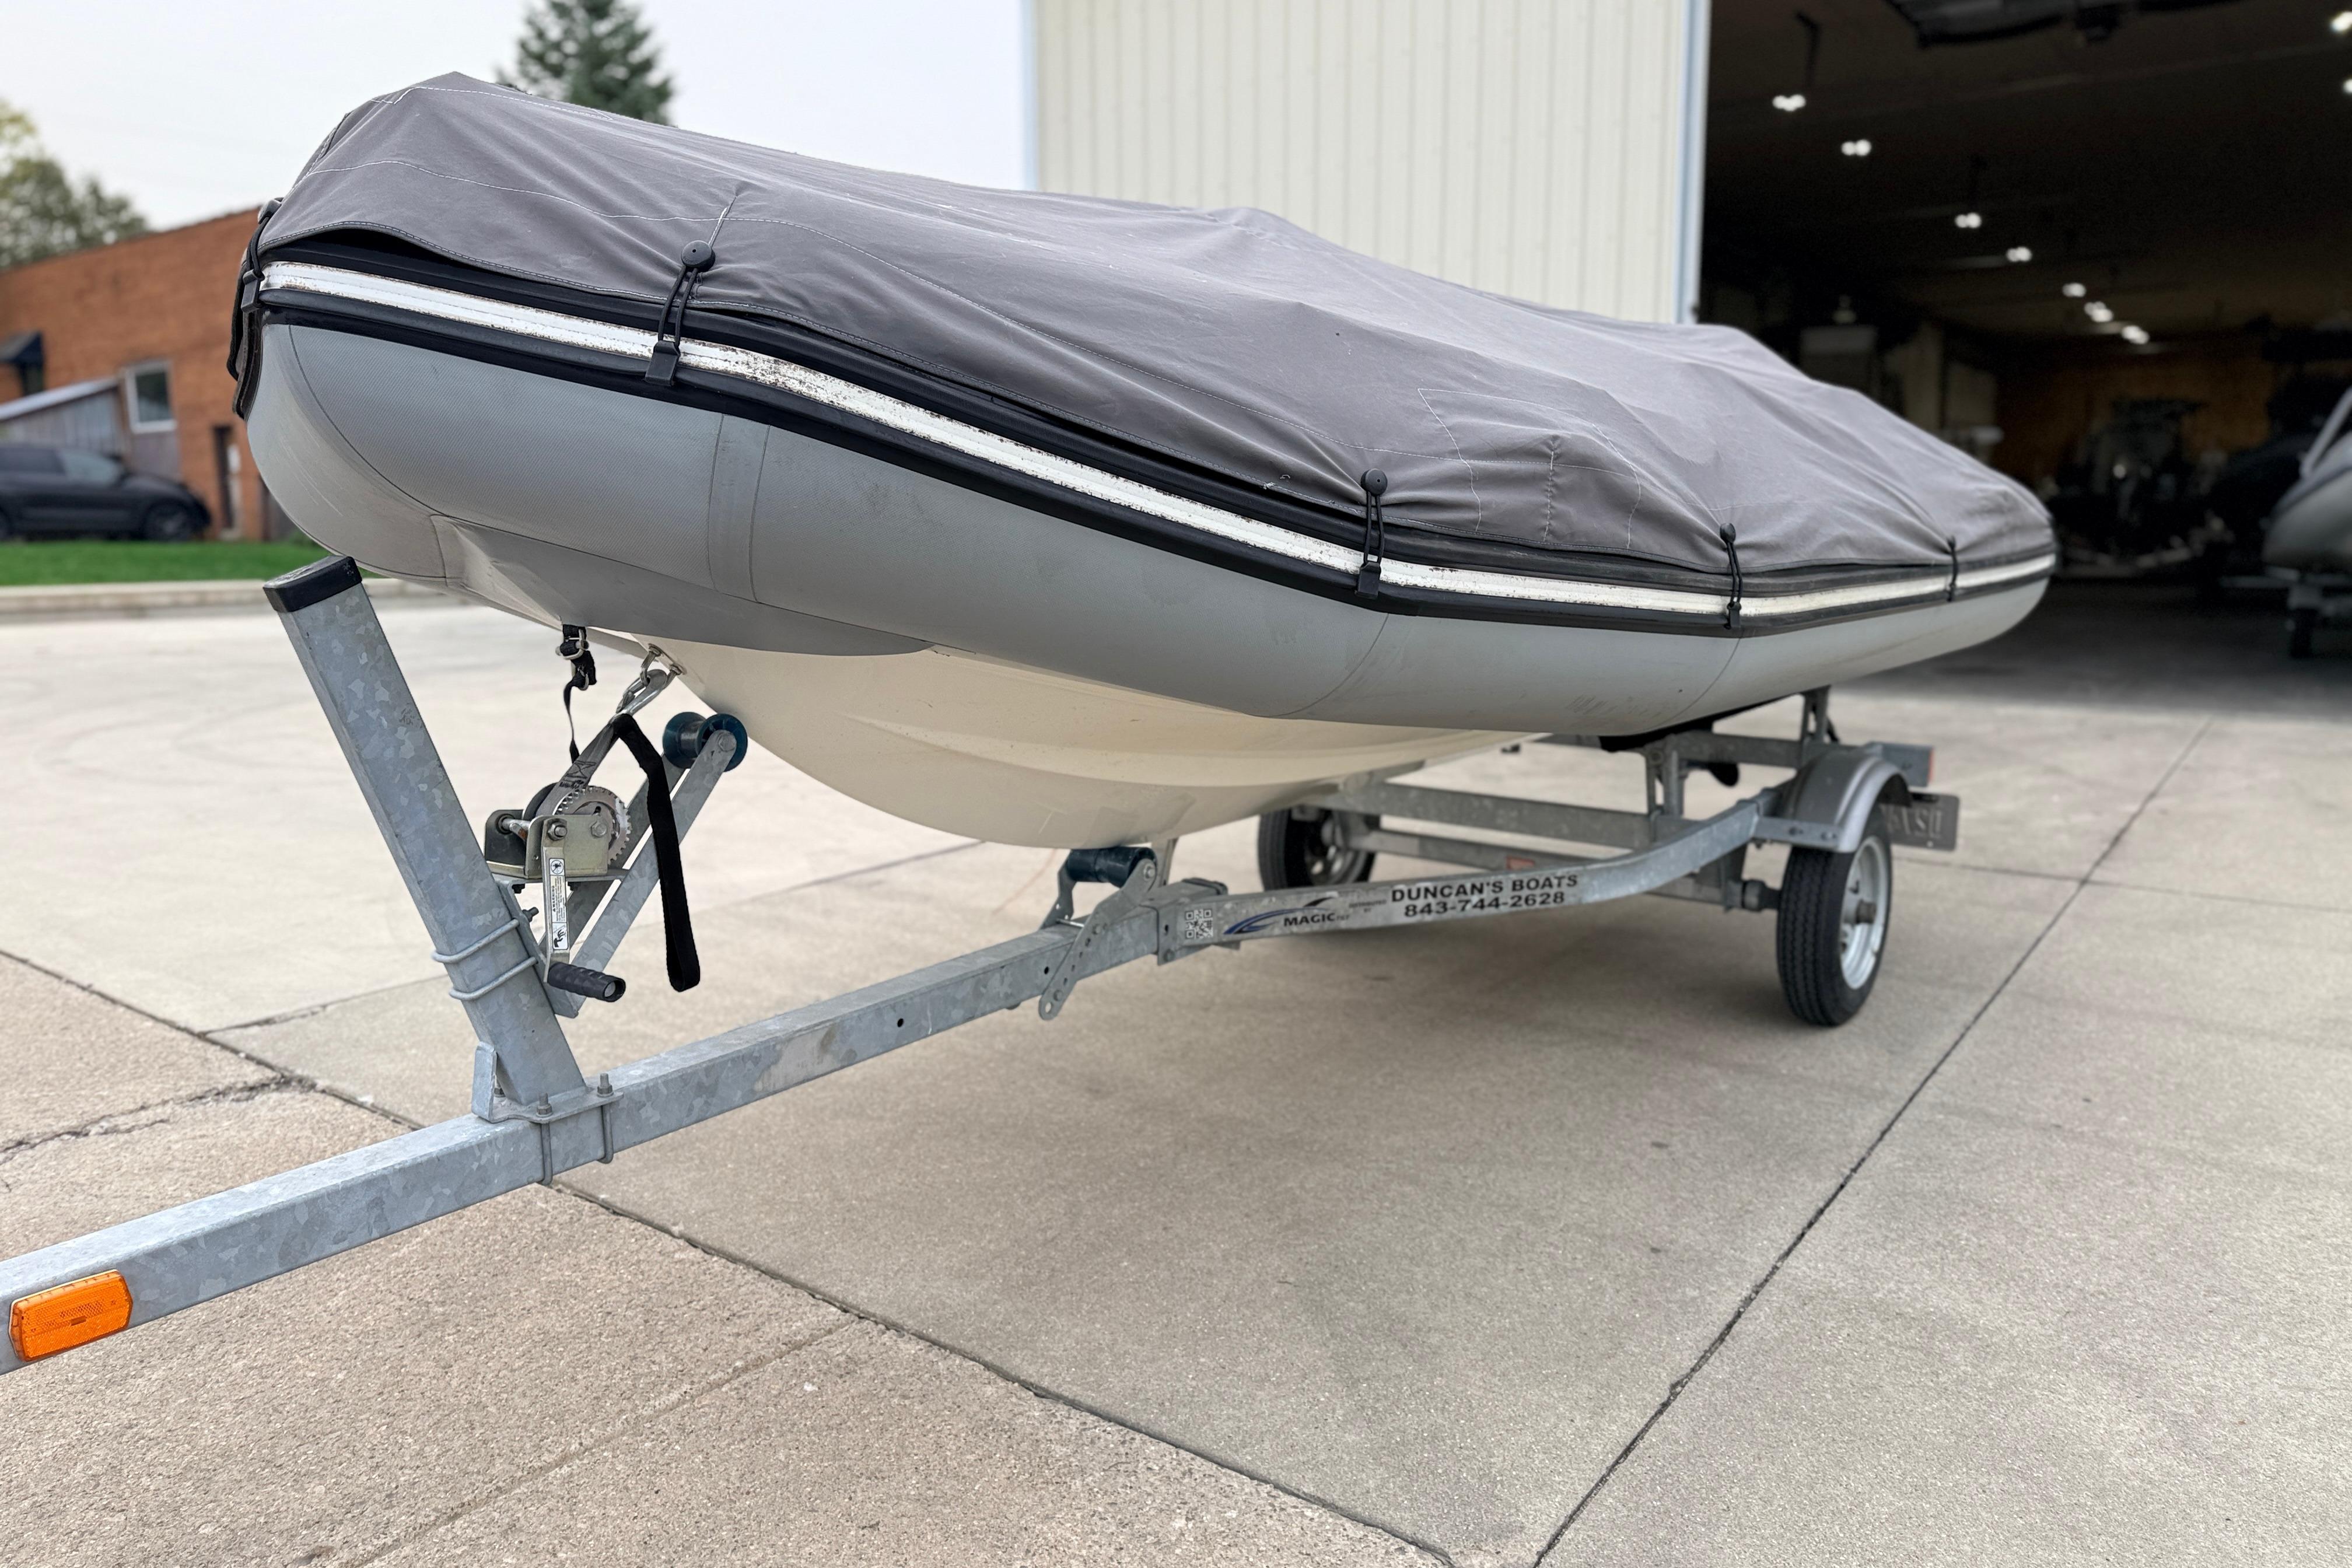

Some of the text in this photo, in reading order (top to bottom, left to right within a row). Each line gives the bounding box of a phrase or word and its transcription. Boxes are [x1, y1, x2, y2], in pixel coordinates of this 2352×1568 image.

[1391, 874, 1578, 902] DUNCAN'S BOATS
[1404, 891, 1565, 917] 843-744-2628
[1284, 912, 1335, 926] MAGIC
